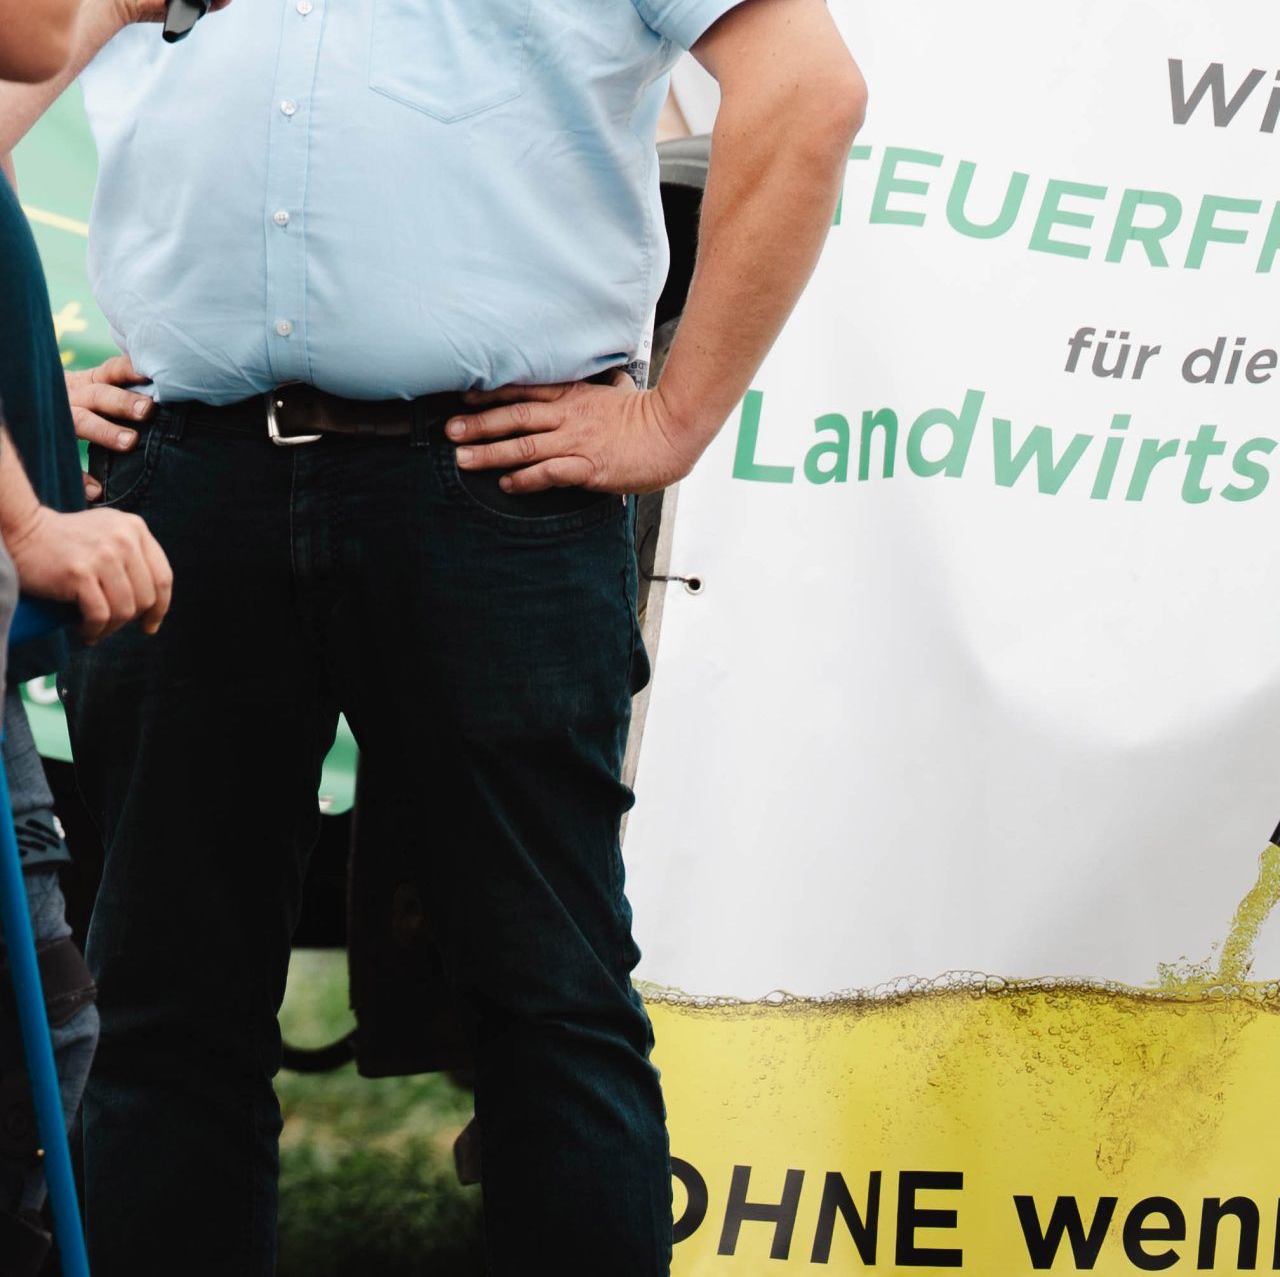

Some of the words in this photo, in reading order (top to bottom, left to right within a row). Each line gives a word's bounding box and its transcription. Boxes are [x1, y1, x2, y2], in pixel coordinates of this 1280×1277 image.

[1064, 326, 1162, 380] für
[1181, 336, 1279, 385] die
[731, 388, 1279, 505] Landwirts
